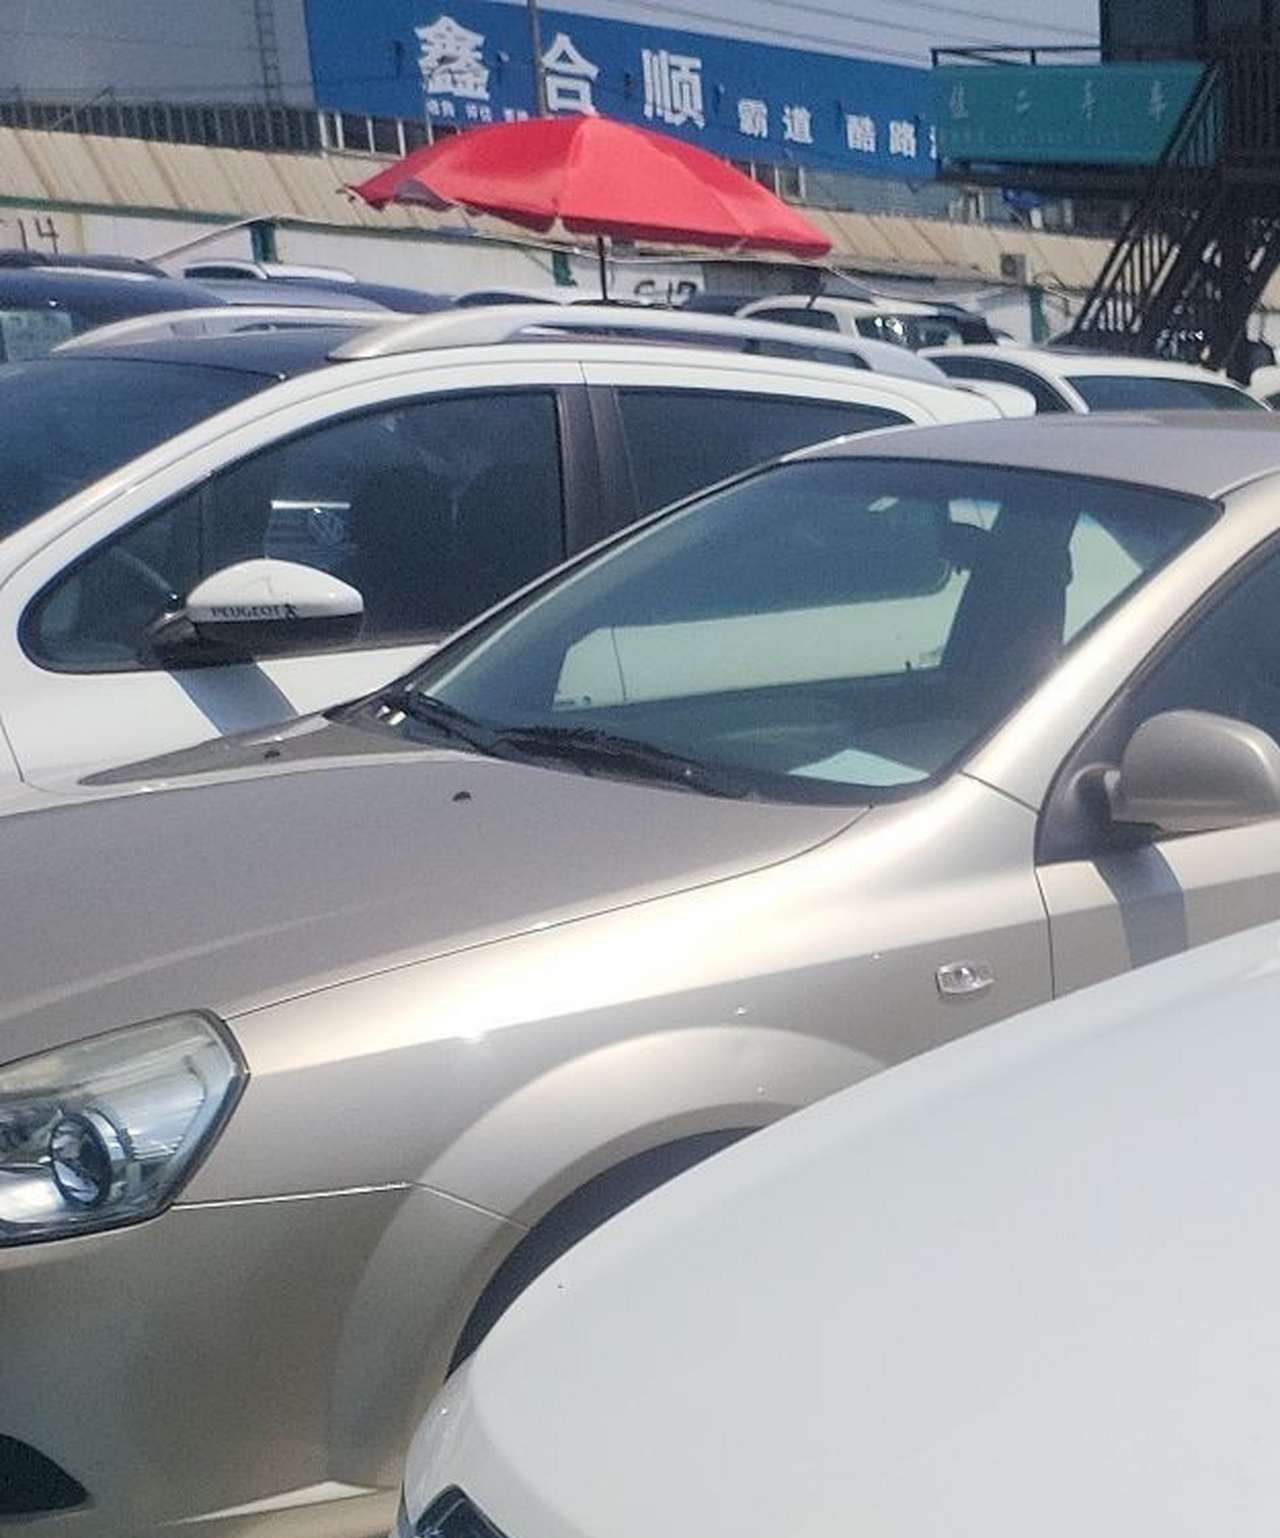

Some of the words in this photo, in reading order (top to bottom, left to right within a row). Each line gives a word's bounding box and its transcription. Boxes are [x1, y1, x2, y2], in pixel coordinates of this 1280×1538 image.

[414, 15, 705, 129] 鑫合顺
[846, 113, 937, 160] 酷路
[211, 604, 281, 618] PEUGEOT
